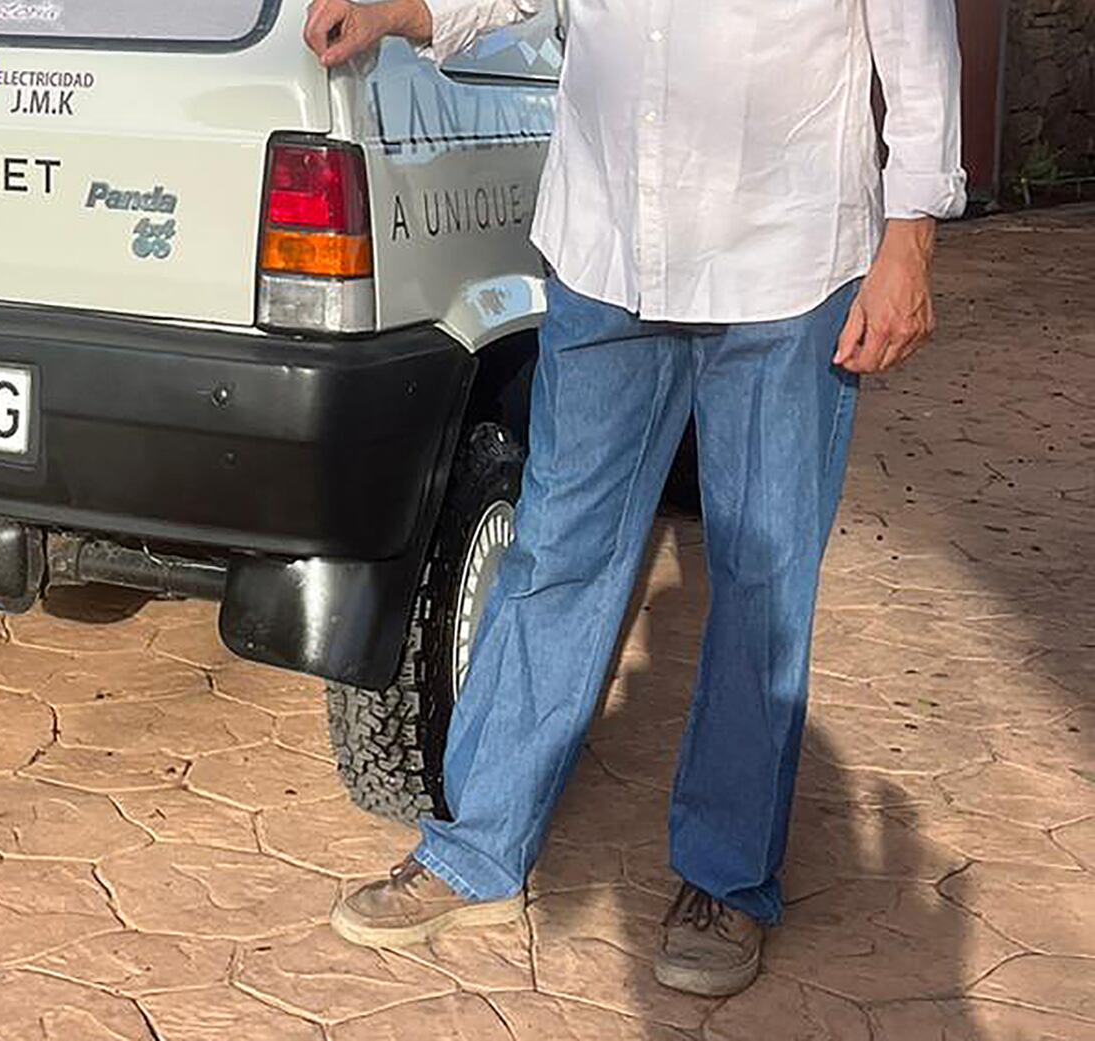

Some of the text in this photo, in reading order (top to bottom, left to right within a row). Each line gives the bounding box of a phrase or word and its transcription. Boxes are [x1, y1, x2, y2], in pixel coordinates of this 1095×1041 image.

[10, 89, 74, 116] J.M.K
[85, 181, 178, 214] Panda
[392, 185, 523, 241] A UNIQUE
